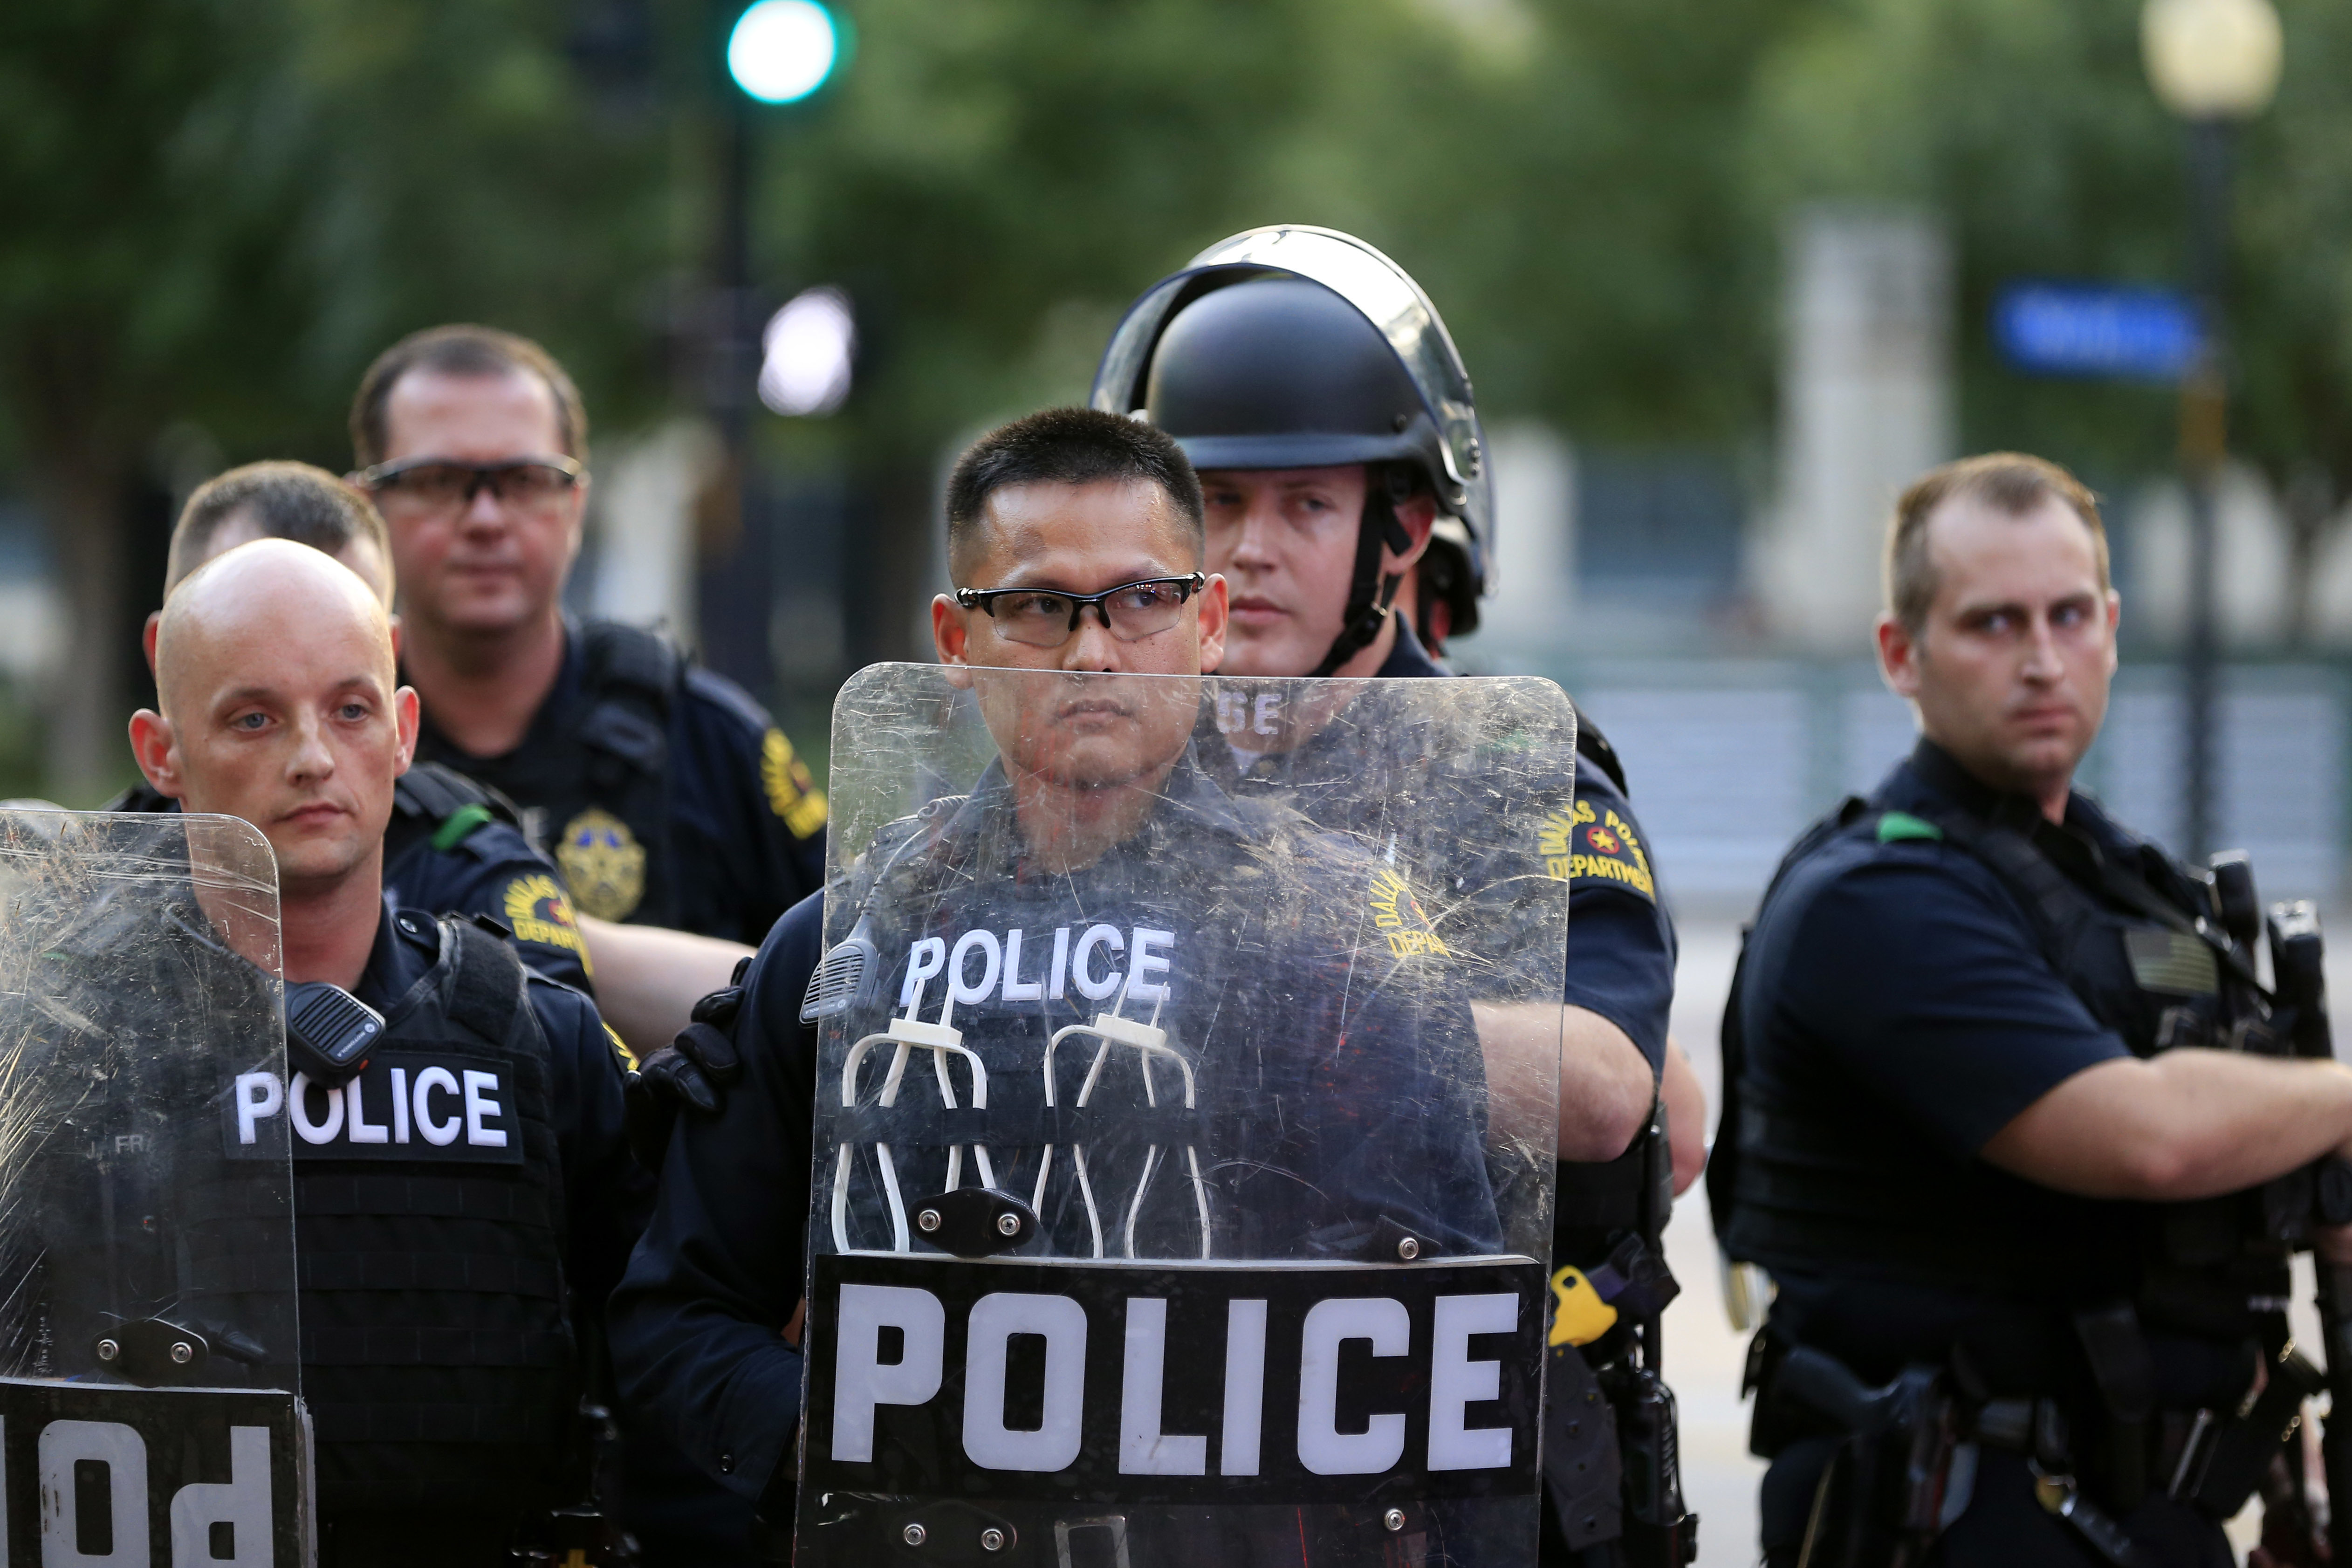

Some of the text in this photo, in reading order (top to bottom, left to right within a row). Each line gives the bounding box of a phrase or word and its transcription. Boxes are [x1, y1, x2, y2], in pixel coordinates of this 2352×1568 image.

[1546, 854, 1656, 905] DEPARTME
[900, 924, 1175, 1007] POLICE
[235, 1066, 507, 1146] POLICE
[831, 1283, 1519, 1476] POLICE
[0, 1414, 274, 1568] PO
